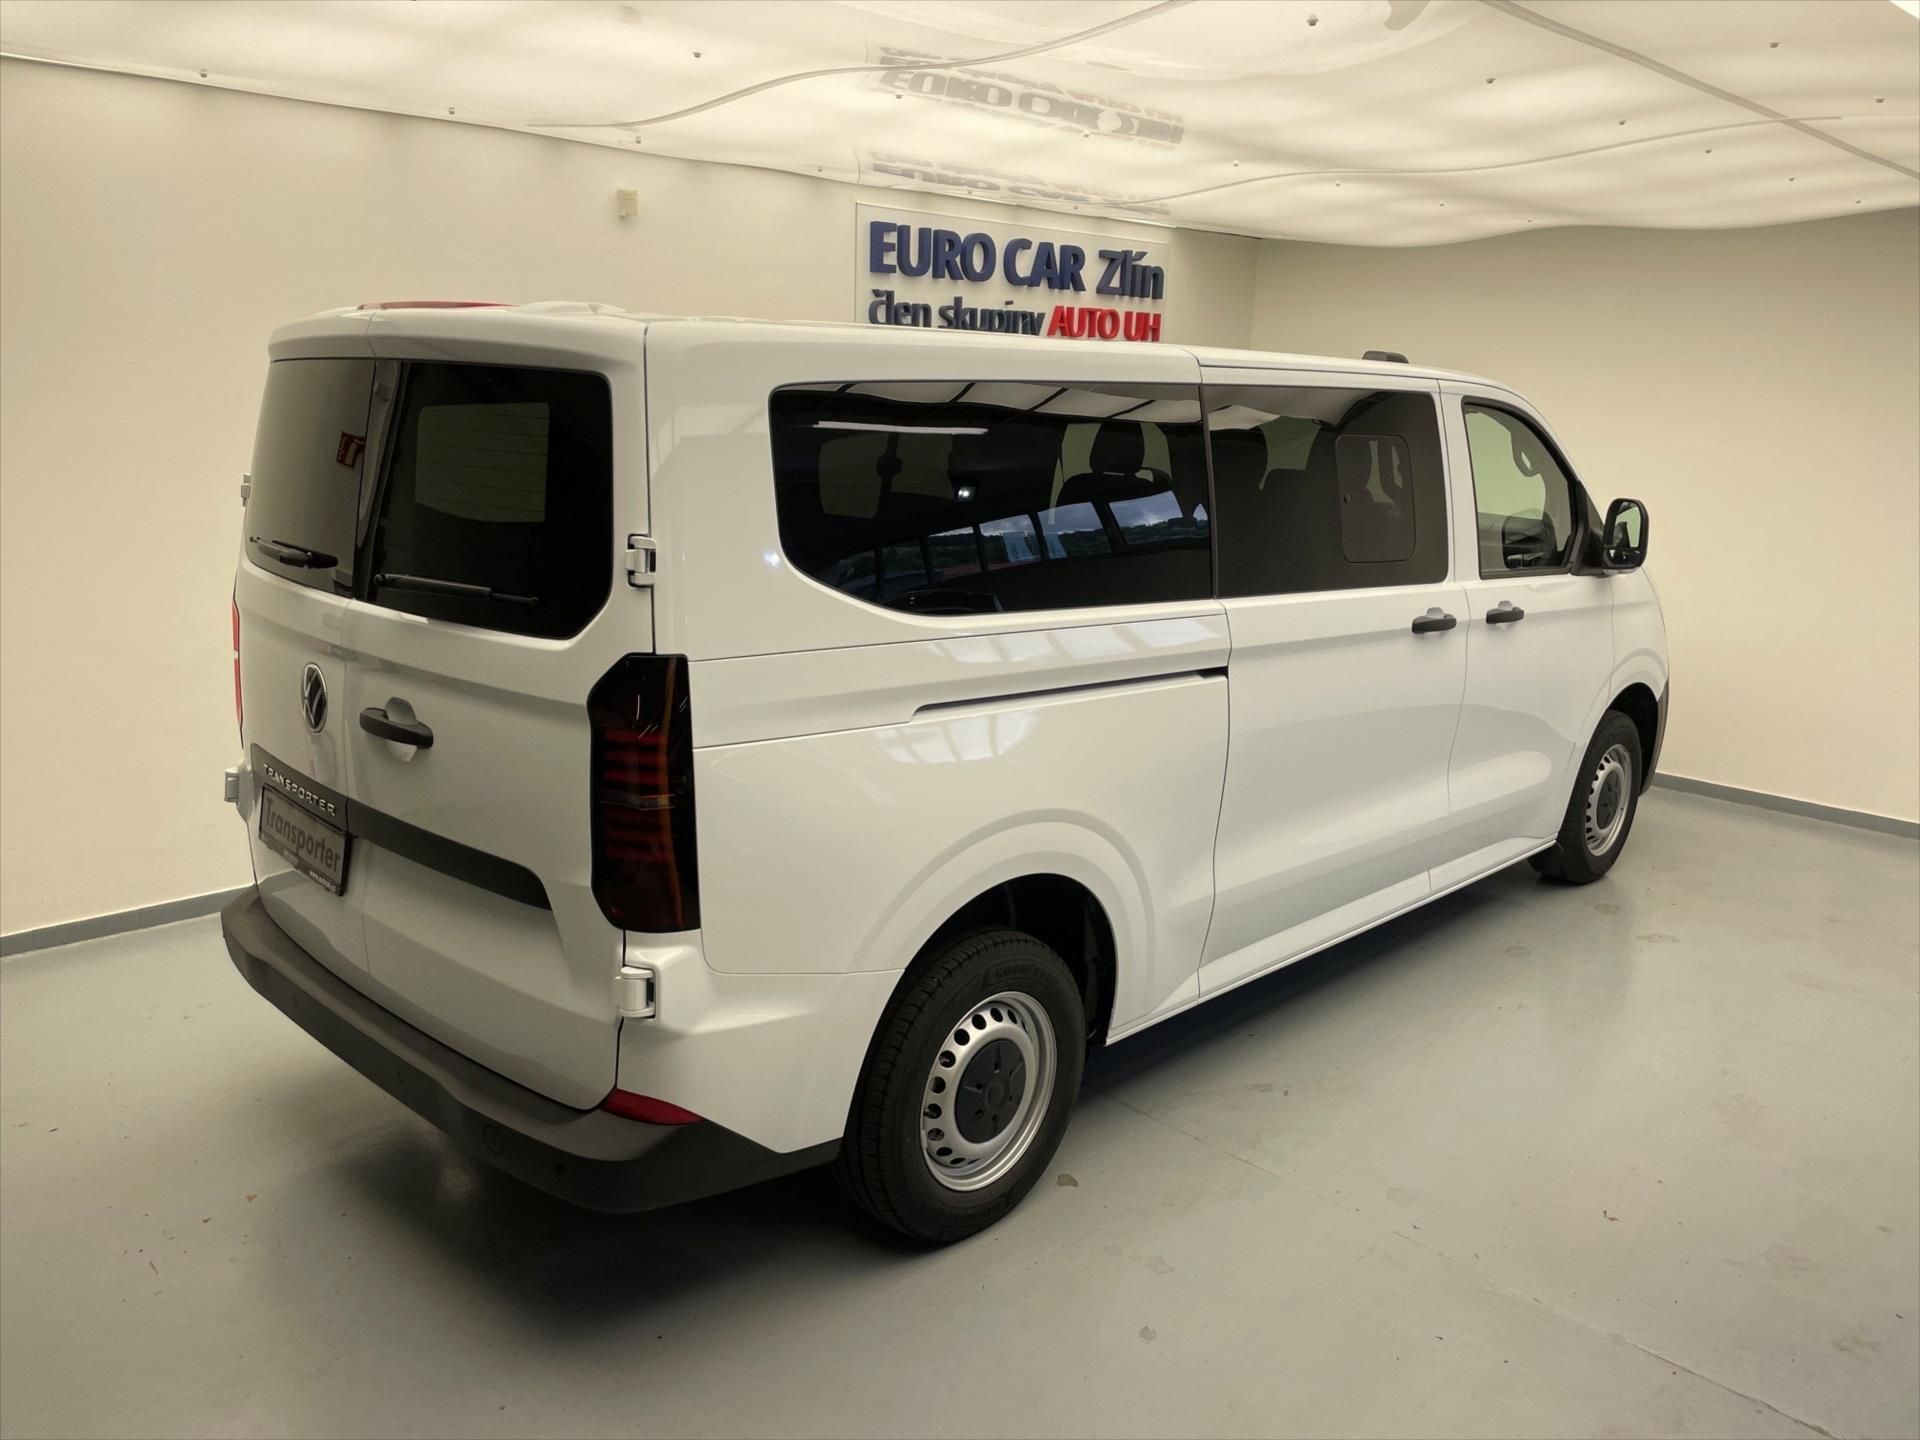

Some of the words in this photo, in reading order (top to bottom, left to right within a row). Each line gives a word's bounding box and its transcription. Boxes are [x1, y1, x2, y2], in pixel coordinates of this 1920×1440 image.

[869, 221, 996, 282] EURO
[1003, 238, 1086, 292] CAR
[1096, 250, 1165, 299] Zlín
[868, 289, 931, 328] člen
[1047, 305, 1120, 340] AUTO
[1124, 312, 1161, 342] UH
[263, 763, 336, 817] TRANSPORTER
[265, 797, 341, 873] Transporter
